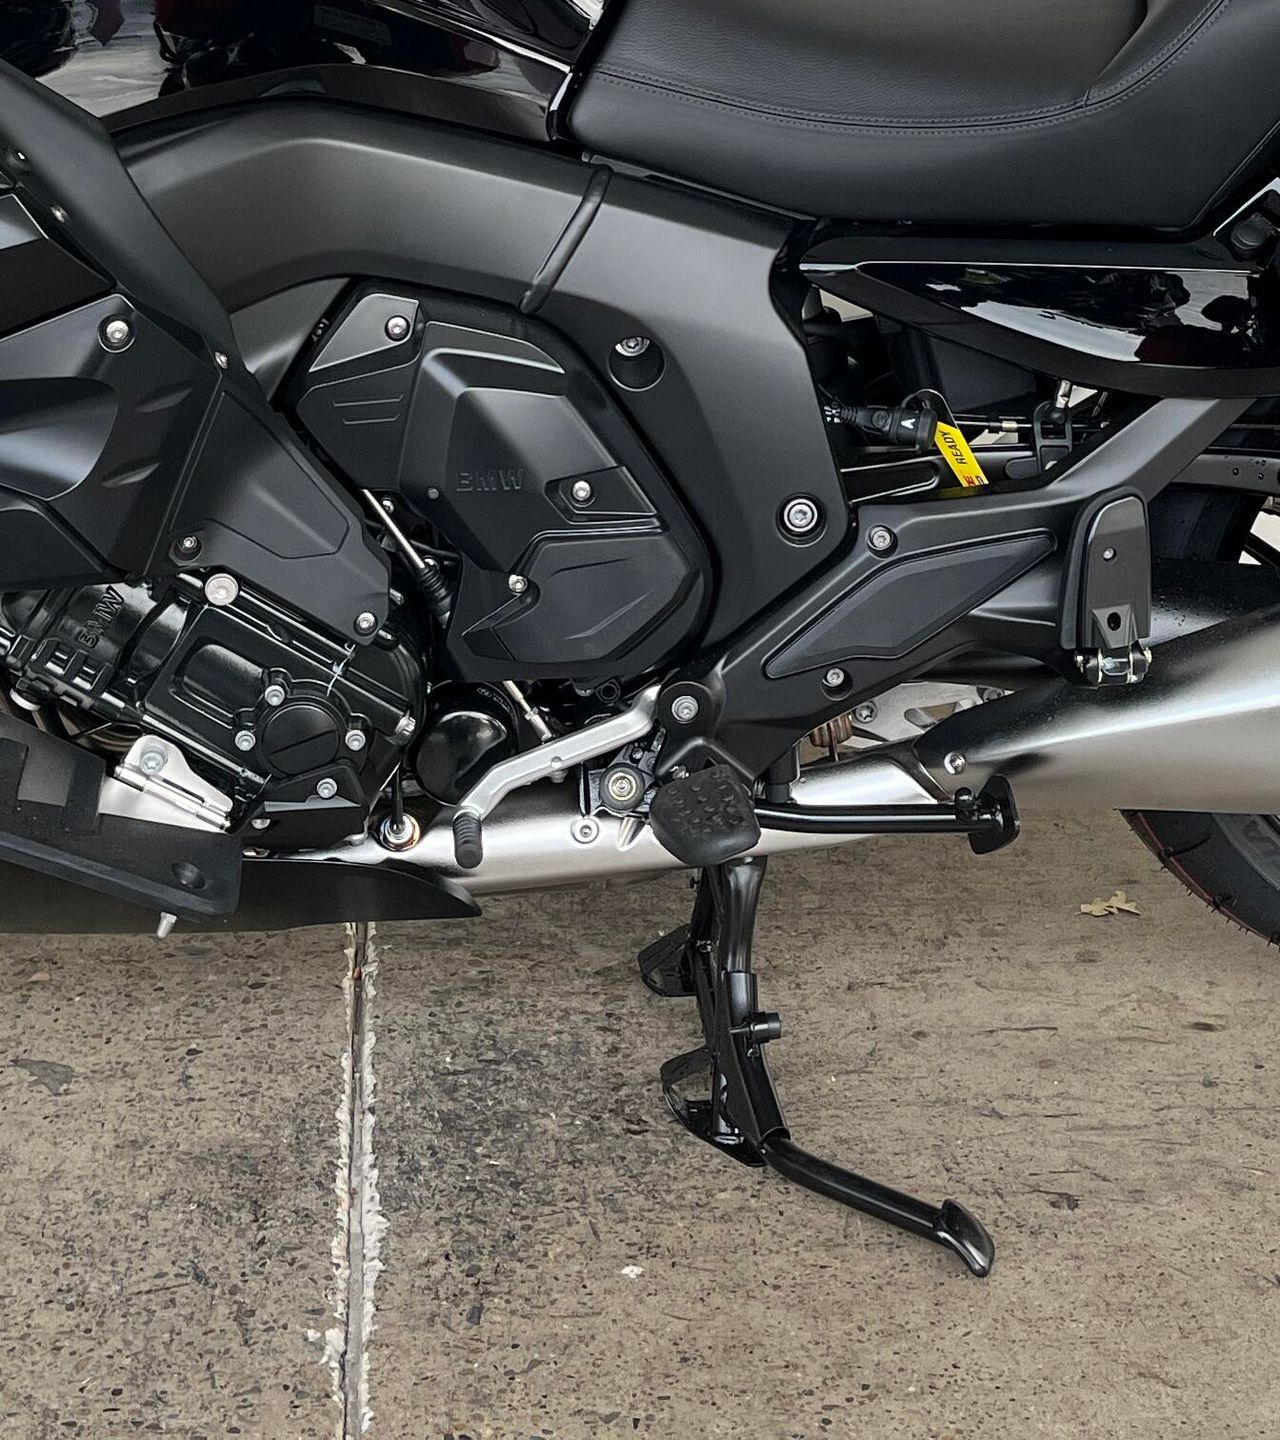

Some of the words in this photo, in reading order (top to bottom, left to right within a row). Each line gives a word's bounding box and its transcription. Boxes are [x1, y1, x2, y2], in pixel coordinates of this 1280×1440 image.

[938, 429, 968, 465] READY
[455, 467, 526, 492] BMW
[76, 584, 125, 649] BMW
